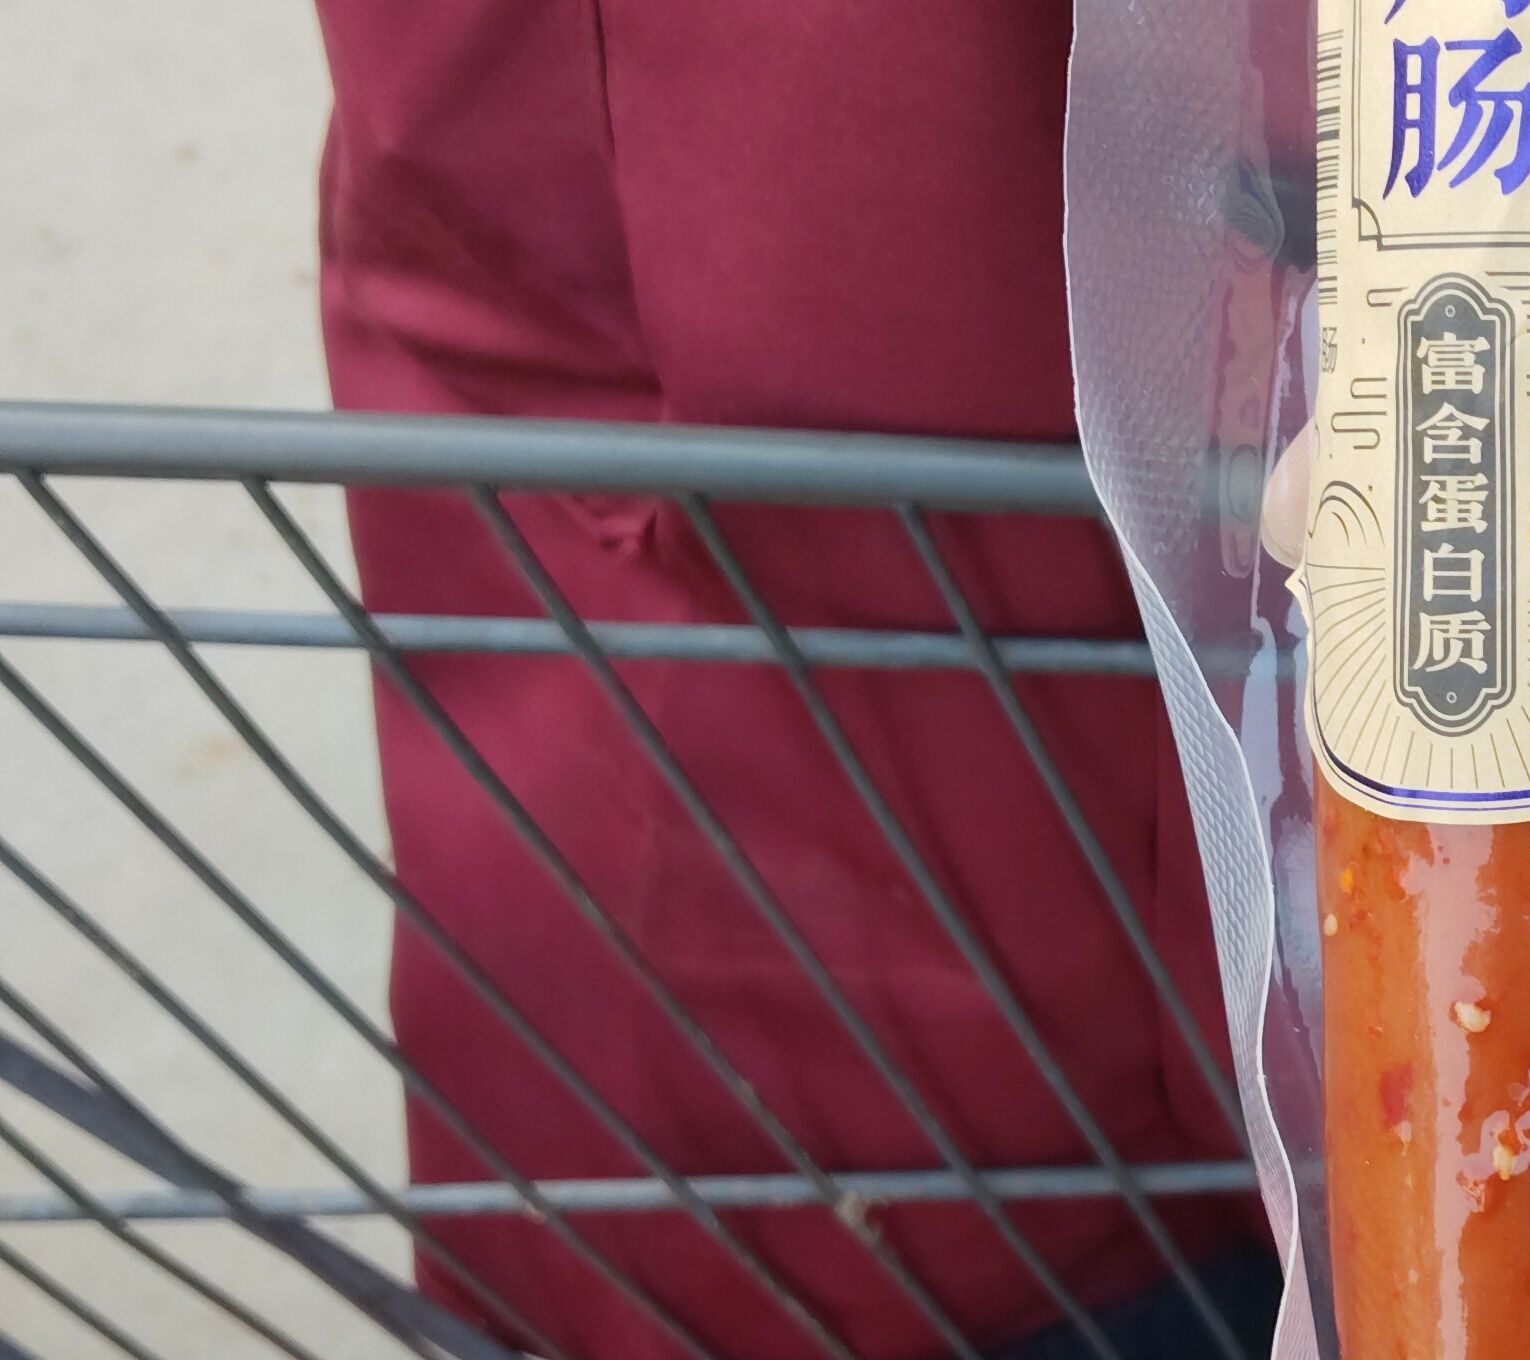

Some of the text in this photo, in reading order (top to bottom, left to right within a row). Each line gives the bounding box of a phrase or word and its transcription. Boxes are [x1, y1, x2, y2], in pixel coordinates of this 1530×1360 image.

[1412, 331, 1491, 676] 富含蛋白质
